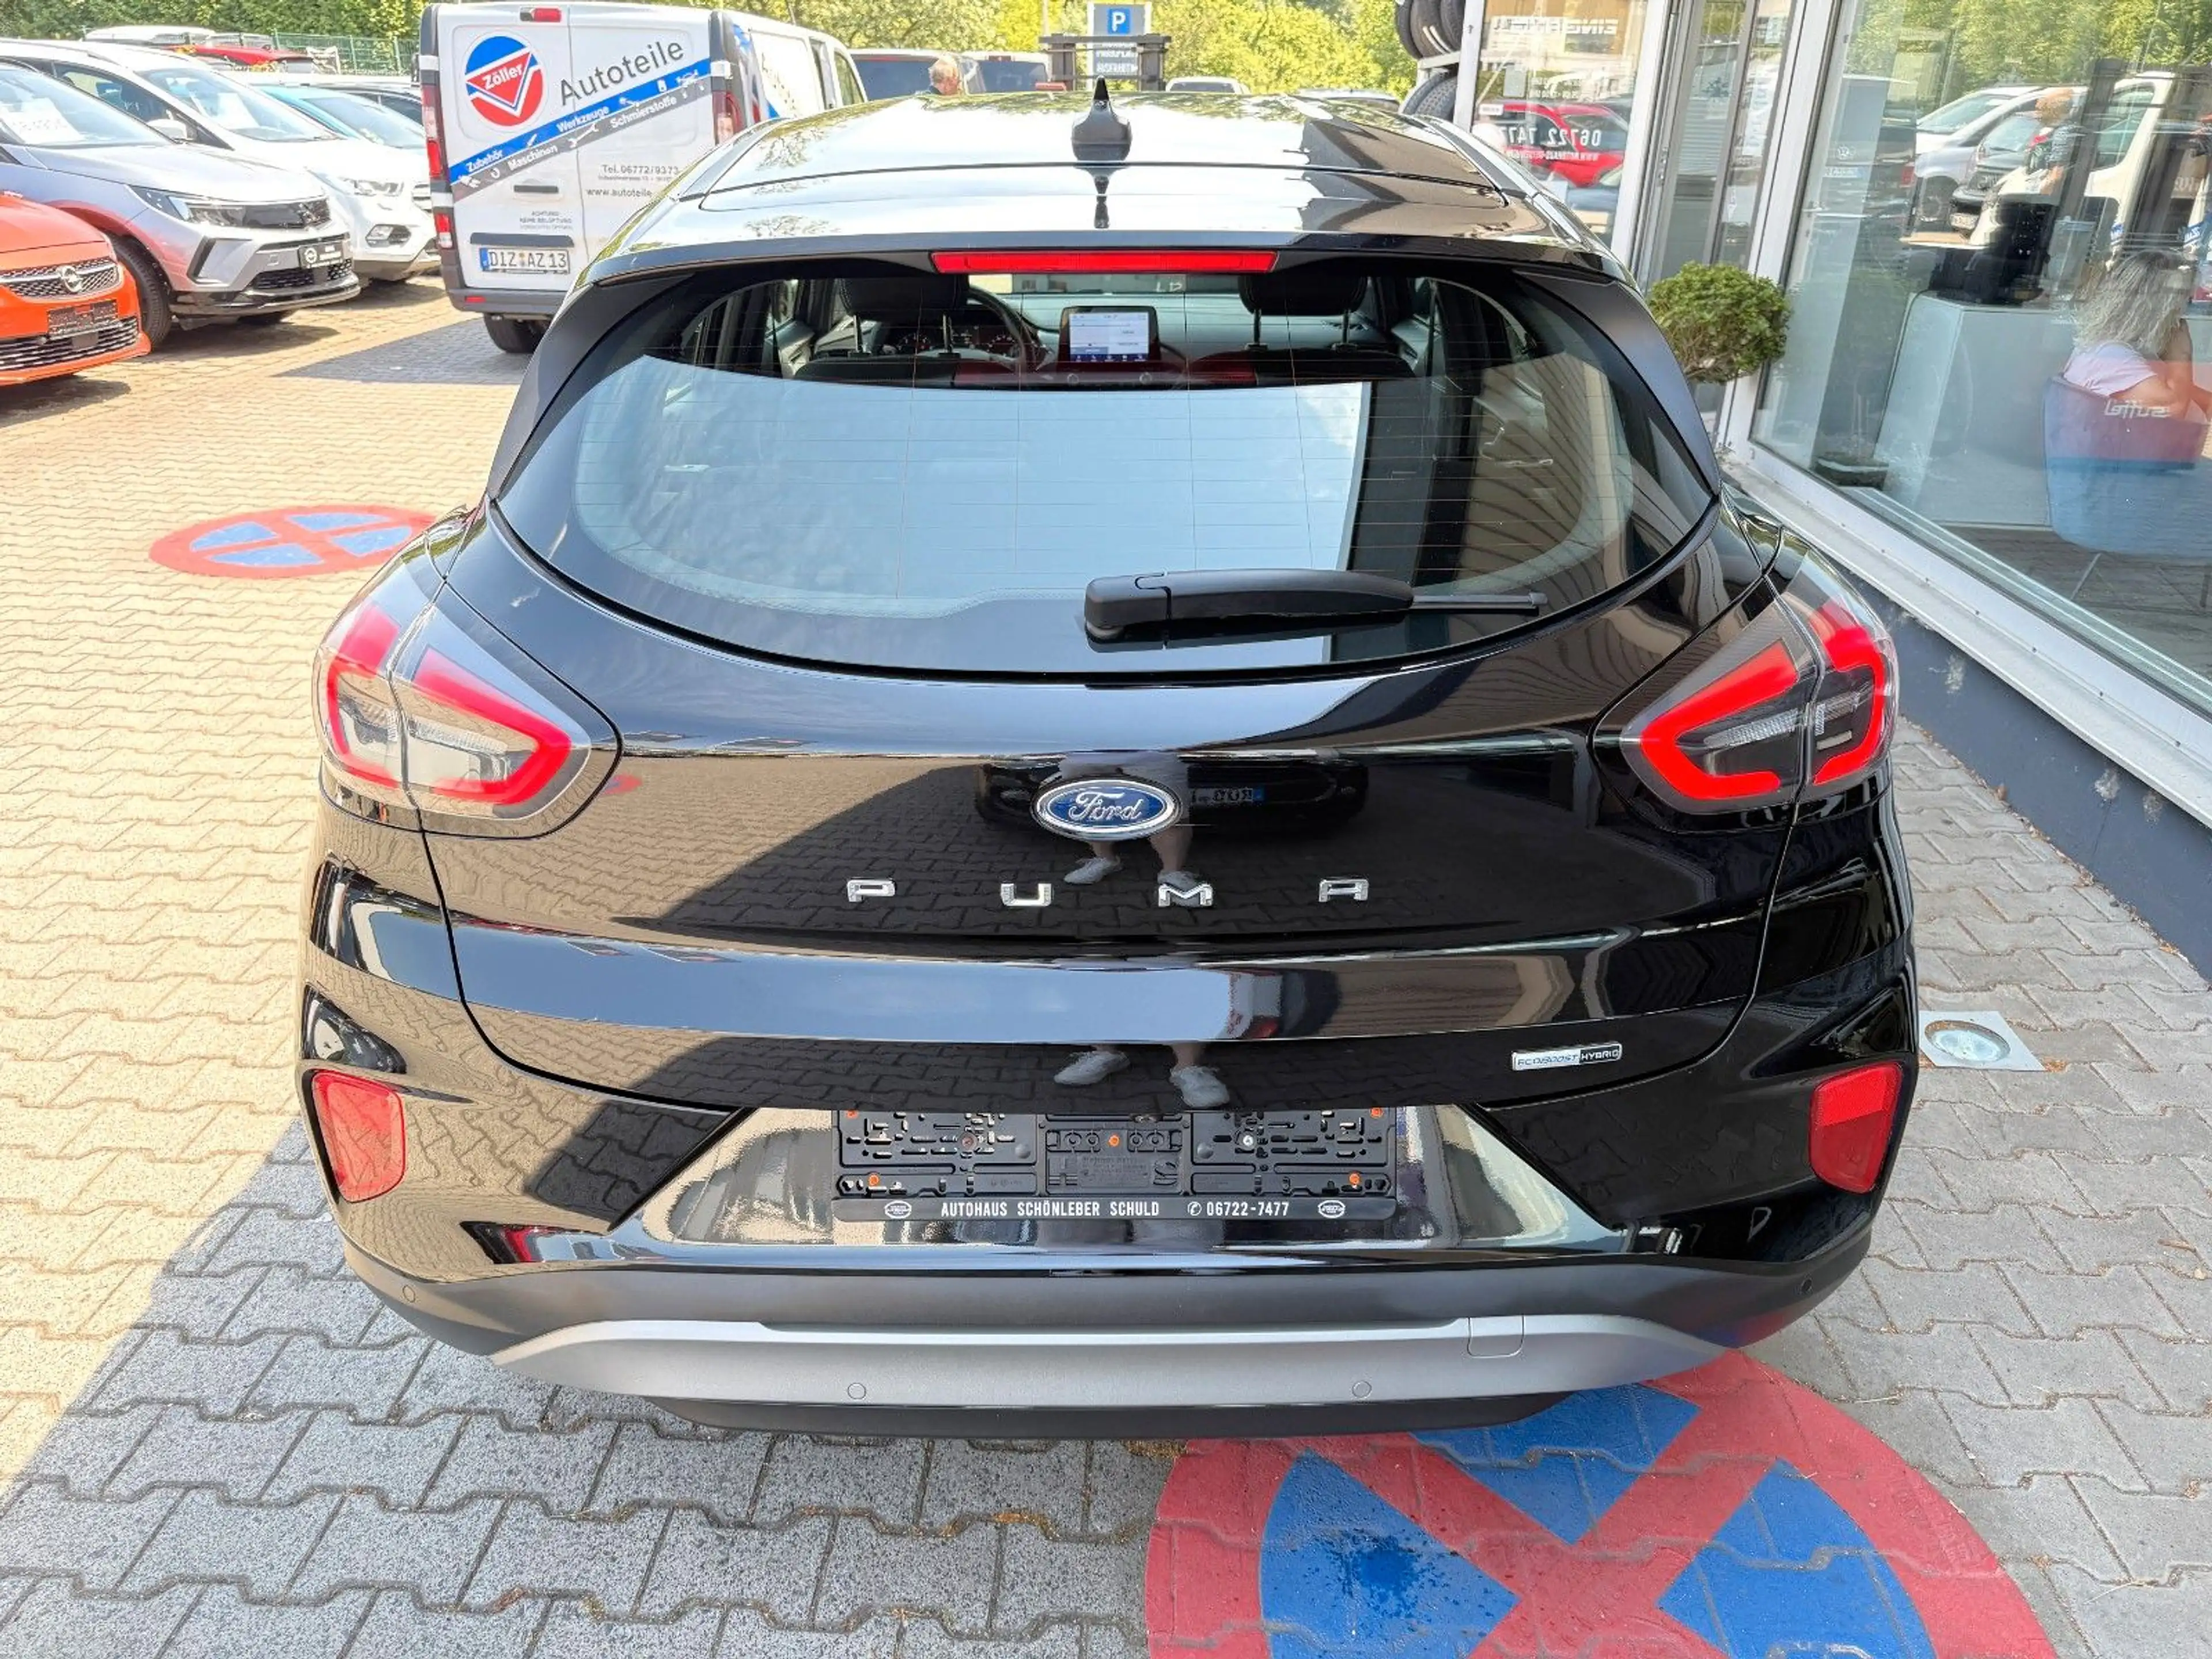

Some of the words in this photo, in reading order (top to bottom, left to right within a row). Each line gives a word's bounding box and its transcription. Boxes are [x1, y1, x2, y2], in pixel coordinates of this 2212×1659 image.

[1111, 11, 1126, 32] P
[482, 63, 524, 89] Zöller
[560, 41, 684, 105] Autoteile
[466, 149, 503, 172] Zubehör
[556, 106, 609, 132] Werkzeuge
[507, 144, 558, 171] Maschinen
[609, 96, 677, 128] Schmierstoffe
[586, 188, 653, 198] www.autoteile
[489, 251, 517, 267] DIZ
[528, 253, 546, 268] AZ
[549, 253, 567, 268] 13
[1069, 791, 1143, 821] Ford
[847, 878, 1369, 907] PUMA
[1517, 1055, 1578, 1066] ECOBOOST
[1581, 1048, 1619, 1061] HYBRID
[941, 1202, 1007, 1217] AUTOHAUS
[1017, 1200, 1100, 1217] SCHÖNLEBER
[1110, 1201, 1160, 1217] SCHULD
[1206, 1201, 1290, 1217] 06722-7477
